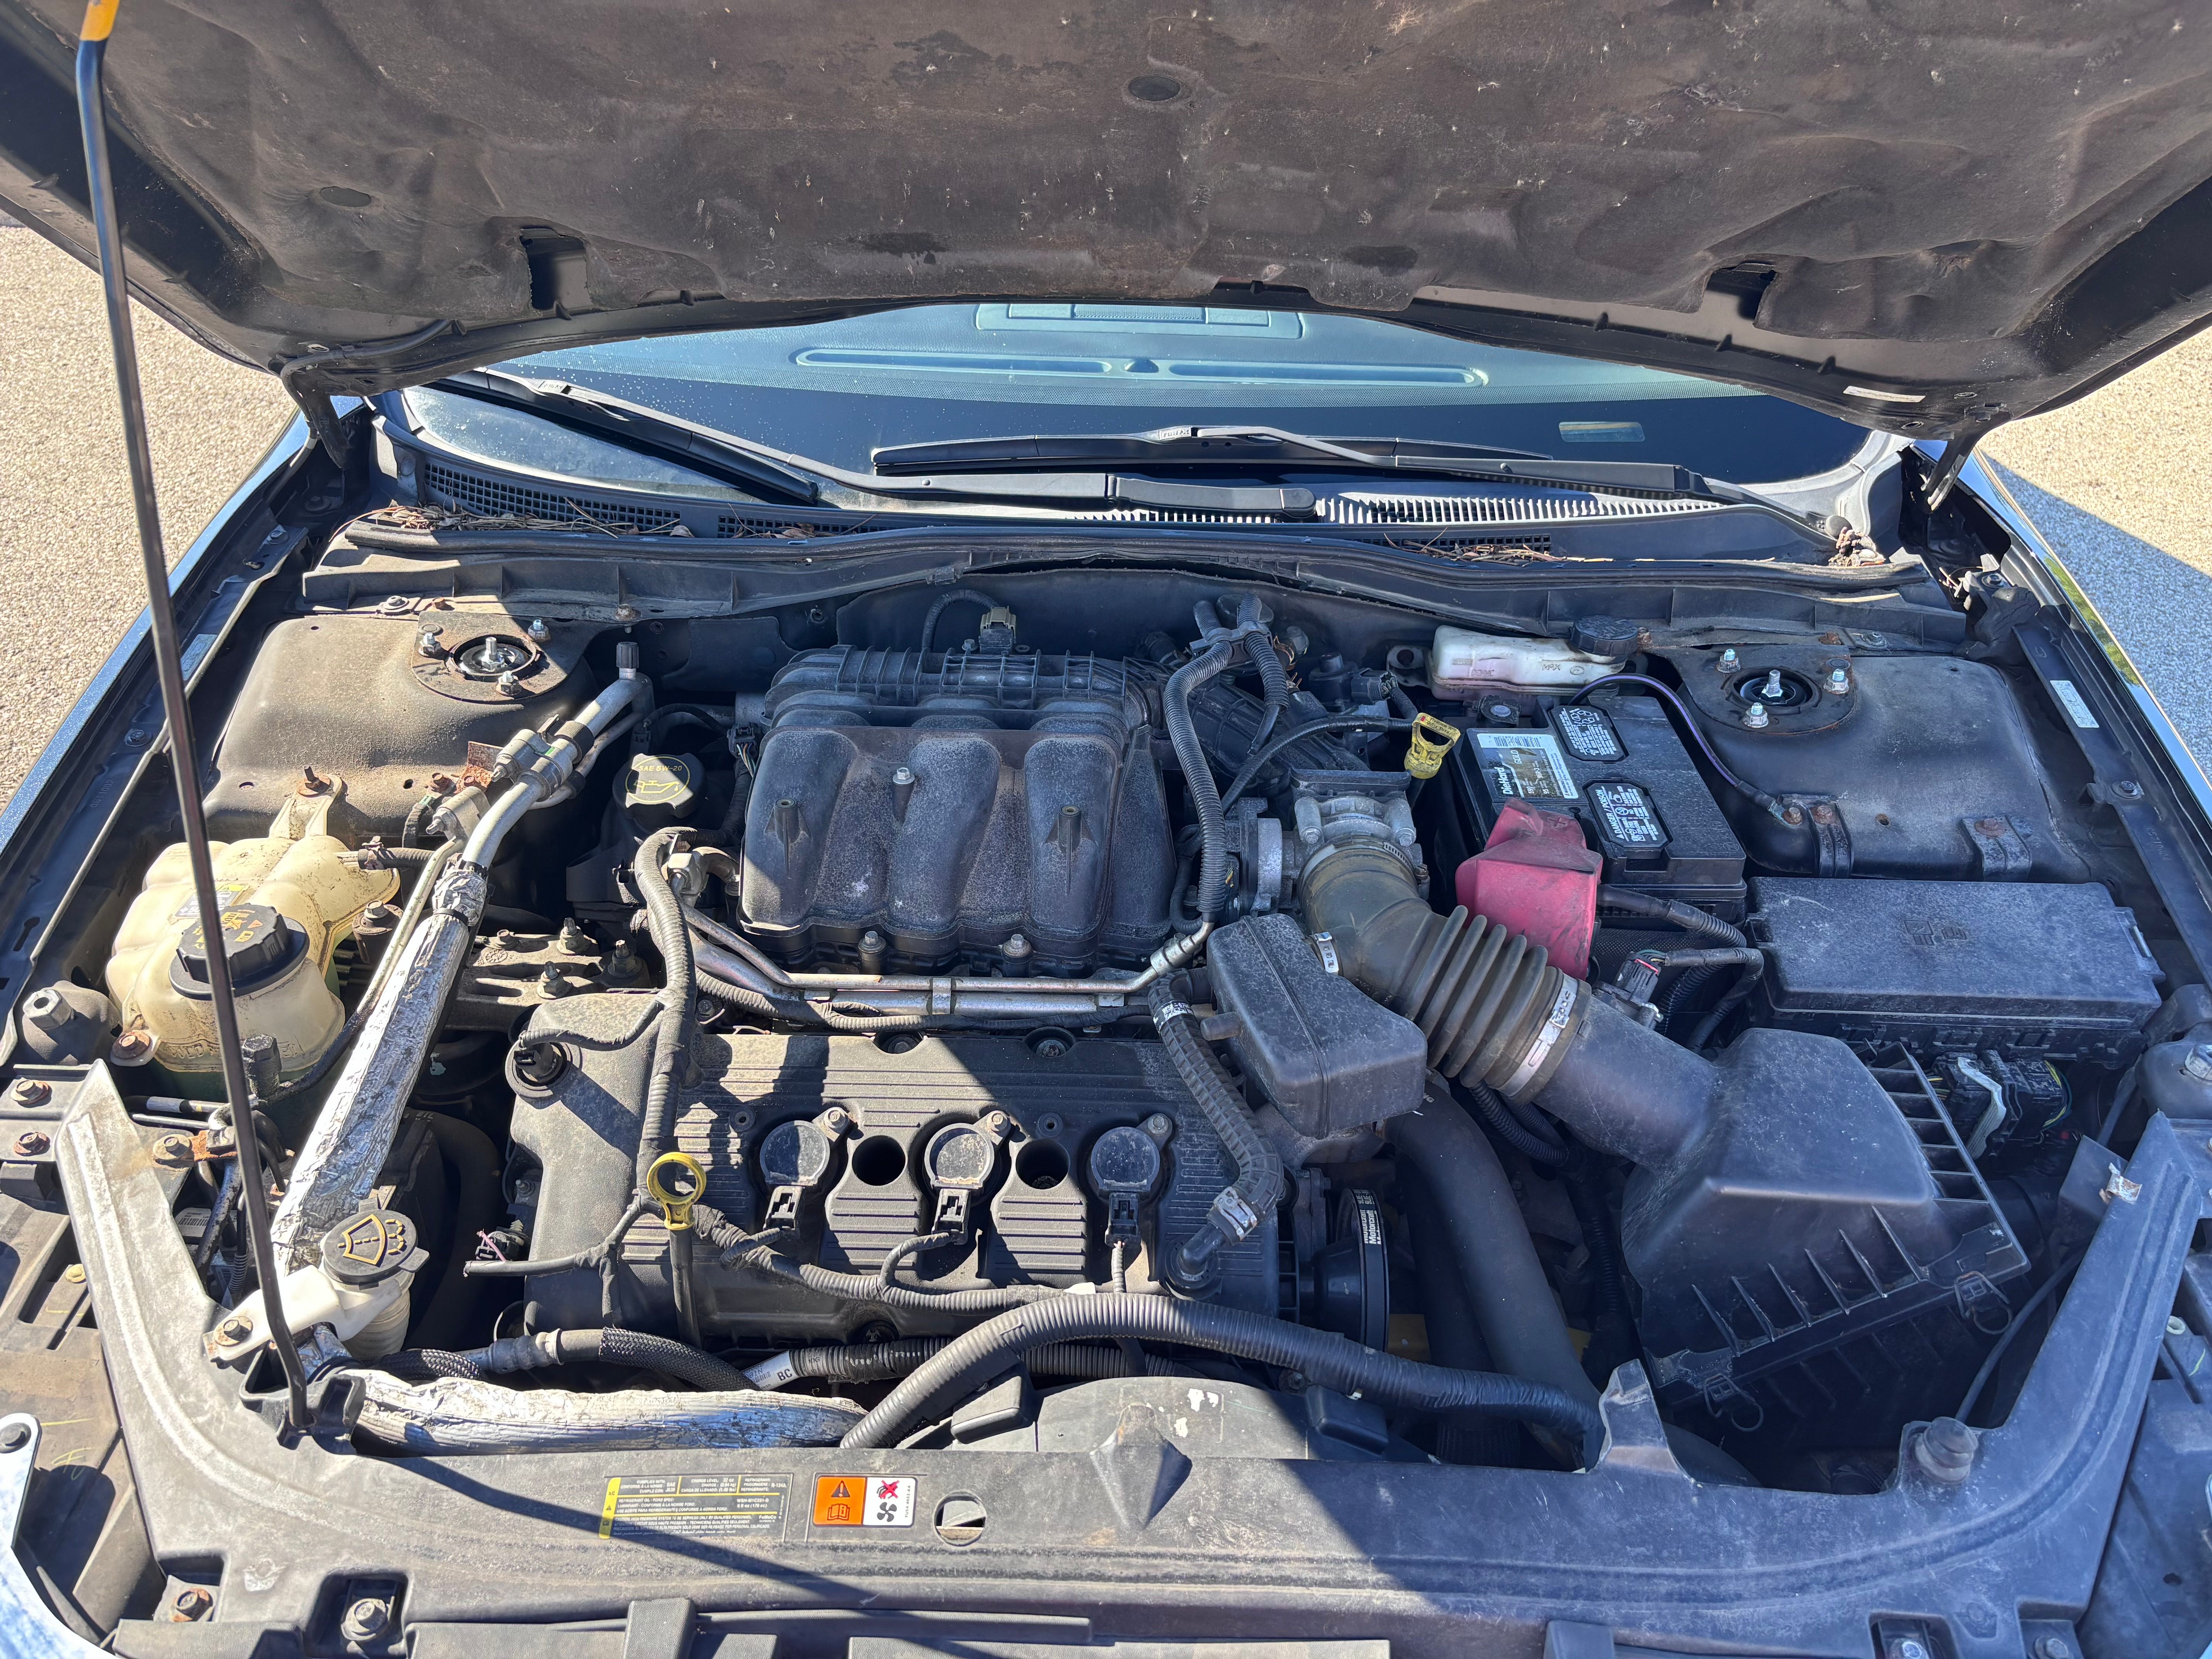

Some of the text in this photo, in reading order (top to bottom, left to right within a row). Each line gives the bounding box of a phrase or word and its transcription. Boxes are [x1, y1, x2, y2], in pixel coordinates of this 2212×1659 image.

[1439, 727, 1452, 735] TRANS
[1511, 750, 1522, 764] GOLD
[1494, 767, 1513, 795] DieHard
[1595, 789, 1611, 808] POISON
[1606, 813, 1622, 834] DANGER
[1367, 1210, 1377, 1245] Motorcraft
[777, 1369, 793, 1381] BC
